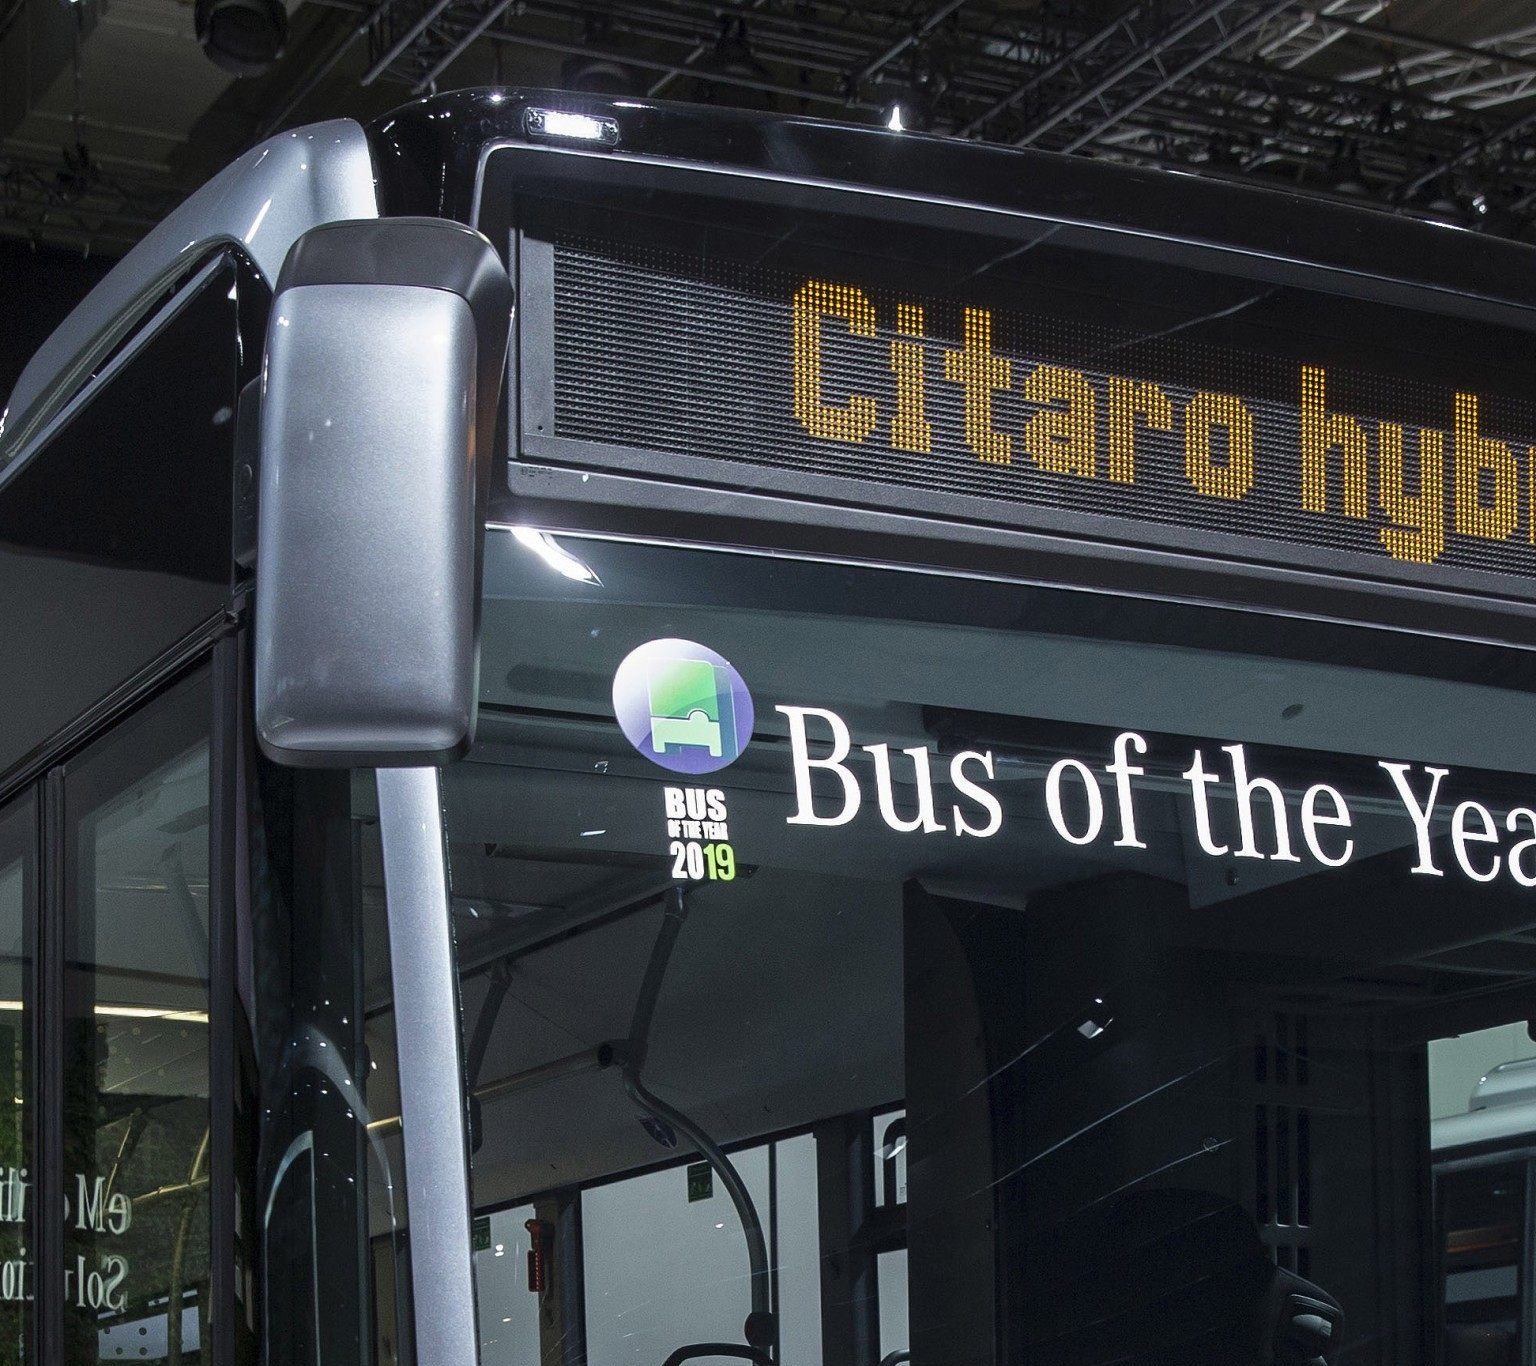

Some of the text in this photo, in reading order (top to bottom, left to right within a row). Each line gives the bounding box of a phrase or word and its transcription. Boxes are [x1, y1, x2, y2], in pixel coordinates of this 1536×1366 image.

[794, 281, 1536, 565] Citaro hyb
[664, 787, 728, 822] BUS
[774, 704, 1003, 838] Bus
[1045, 732, 1147, 849] of
[1182, 743, 1355, 867] the
[669, 841, 736, 881] 2019
